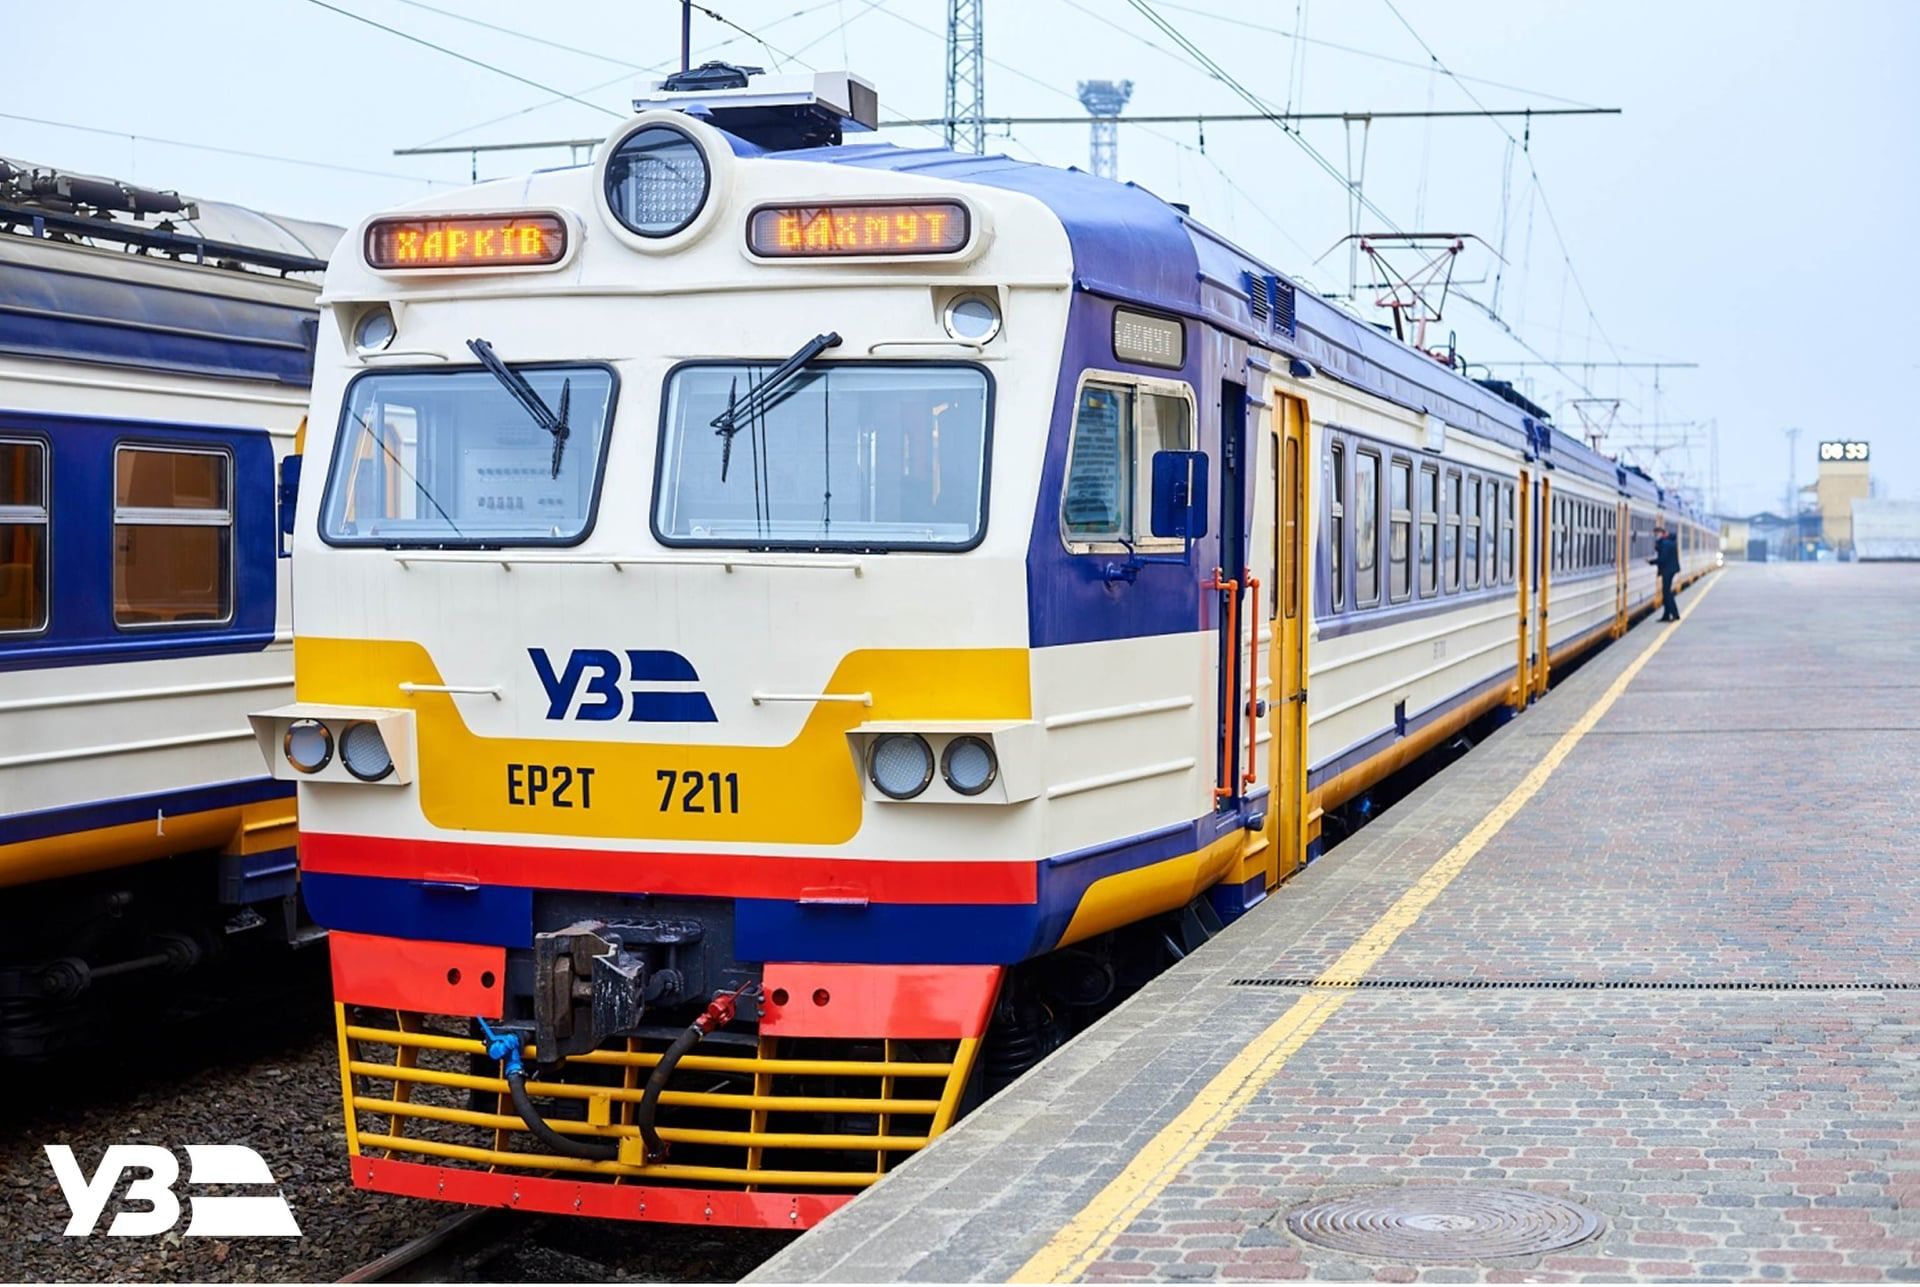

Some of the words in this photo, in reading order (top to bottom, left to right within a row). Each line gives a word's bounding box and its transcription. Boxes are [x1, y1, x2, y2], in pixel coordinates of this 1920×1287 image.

[397, 225, 542, 261] ХАРКІВ
[779, 212, 946, 247] БАХМУТ
[656, 769, 739, 813] 7211
